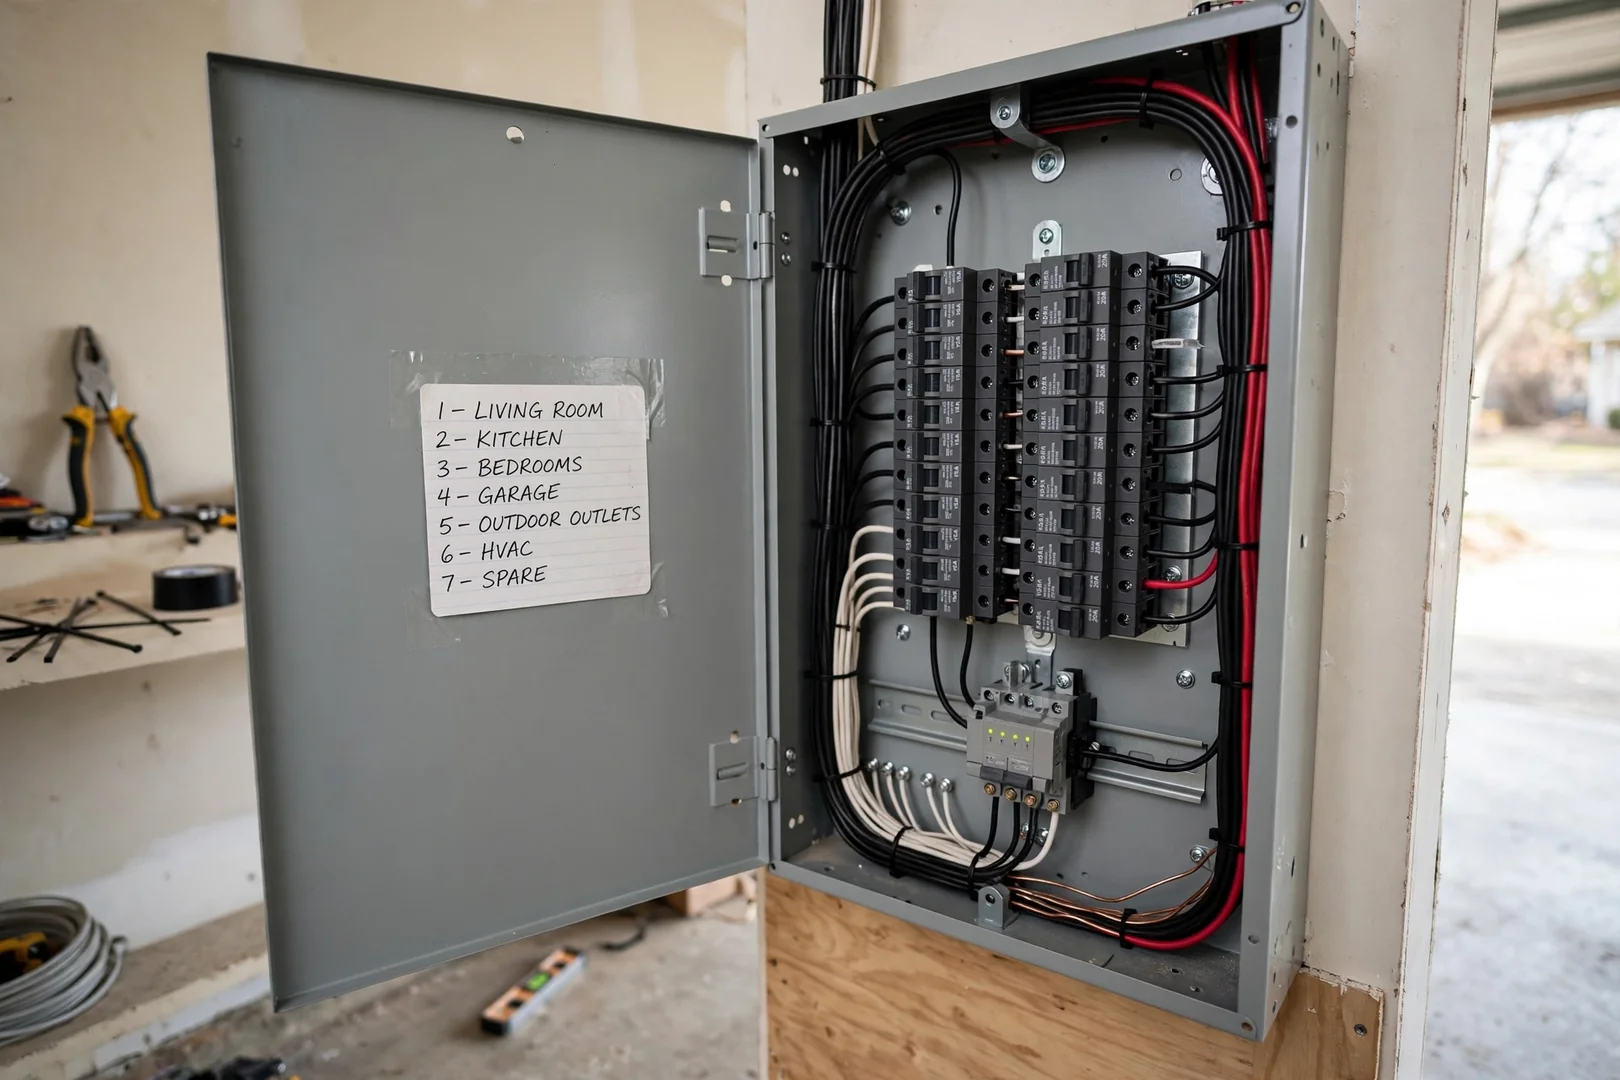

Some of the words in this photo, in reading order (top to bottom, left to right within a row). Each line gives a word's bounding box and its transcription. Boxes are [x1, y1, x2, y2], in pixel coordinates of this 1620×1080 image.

[474, 400, 544, 420] LIVING
[552, 400, 604, 419] ROOM
[476, 429, 563, 449] KITCHEN
[477, 455, 583, 478] BEDROOMS
[478, 482, 561, 505] GARAGE
[478, 510, 562, 533] OUTDOOR
[569, 505, 642, 526] OUTLETS
[481, 540, 533, 561] HVAC
[482, 564, 548, 589] SPARE
